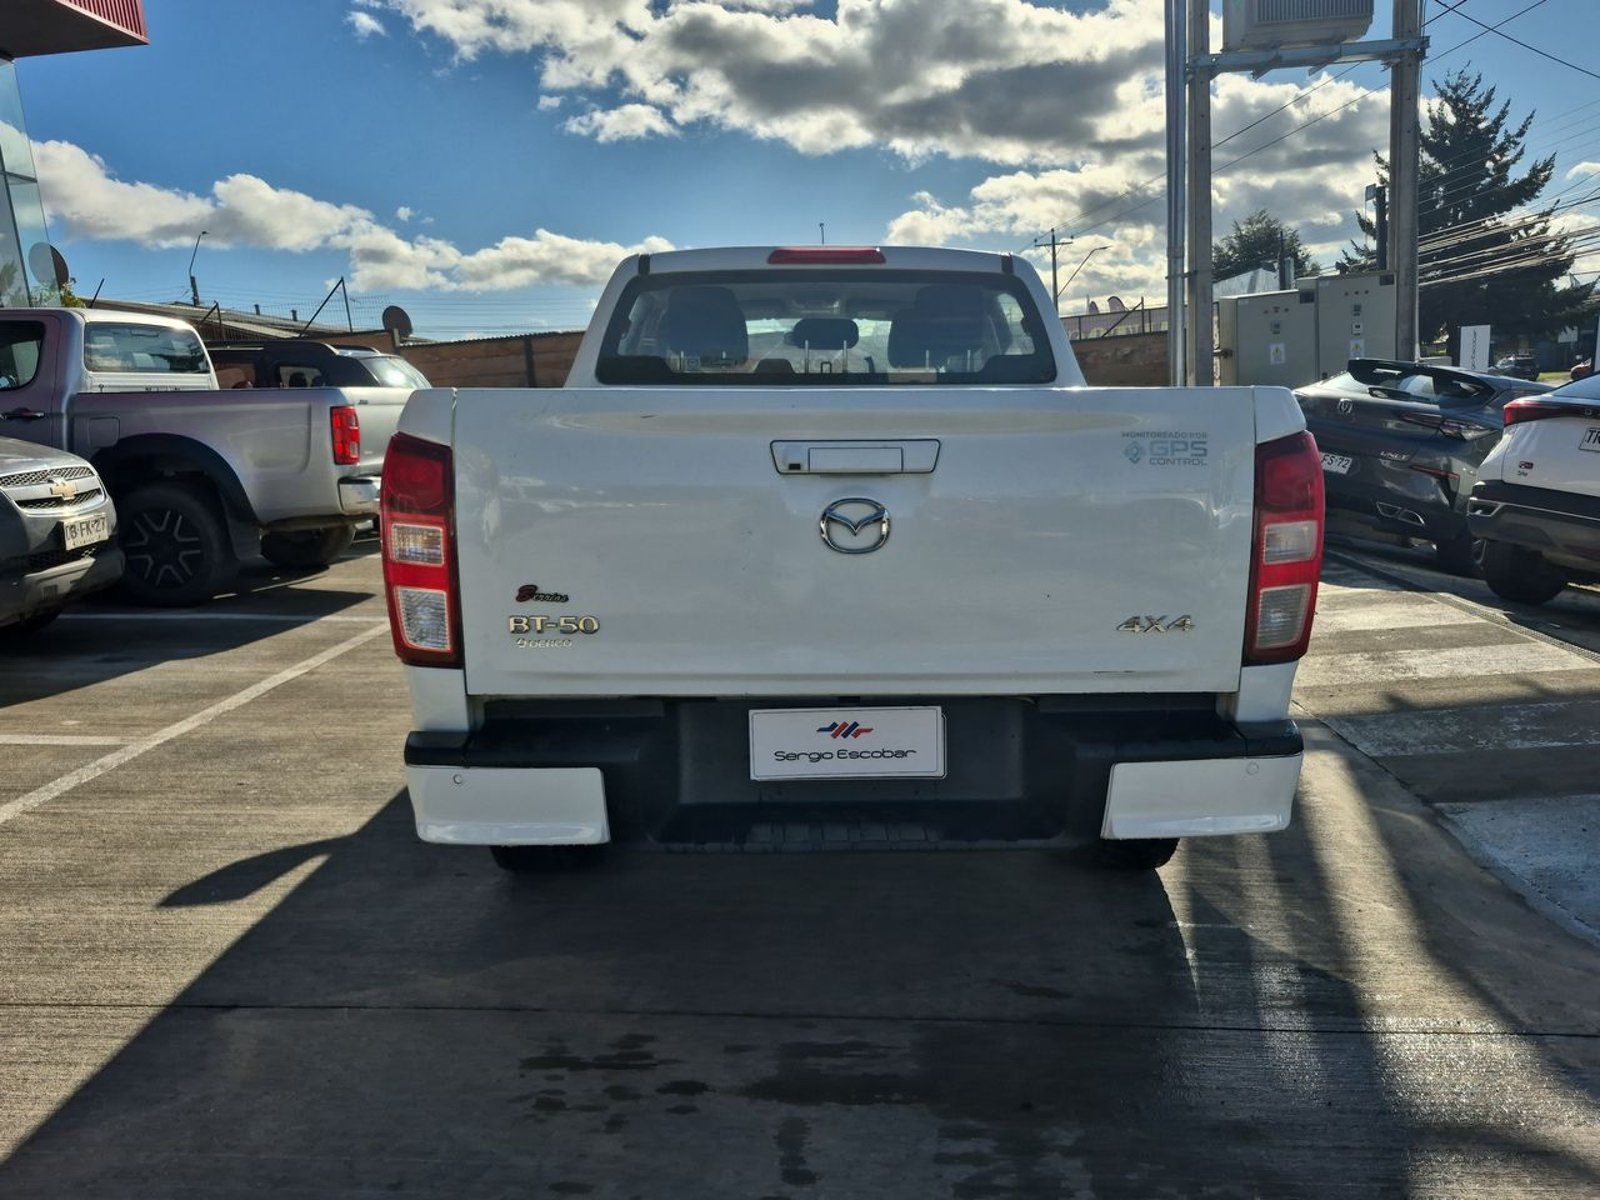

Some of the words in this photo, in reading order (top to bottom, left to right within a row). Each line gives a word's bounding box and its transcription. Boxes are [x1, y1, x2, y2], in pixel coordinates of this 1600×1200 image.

[1149, 440, 1208, 457] GPS
[1149, 457, 1208, 466] CONTROL
[508, 615, 600, 635] BT-50
[836, 748, 917, 760] Escobar
